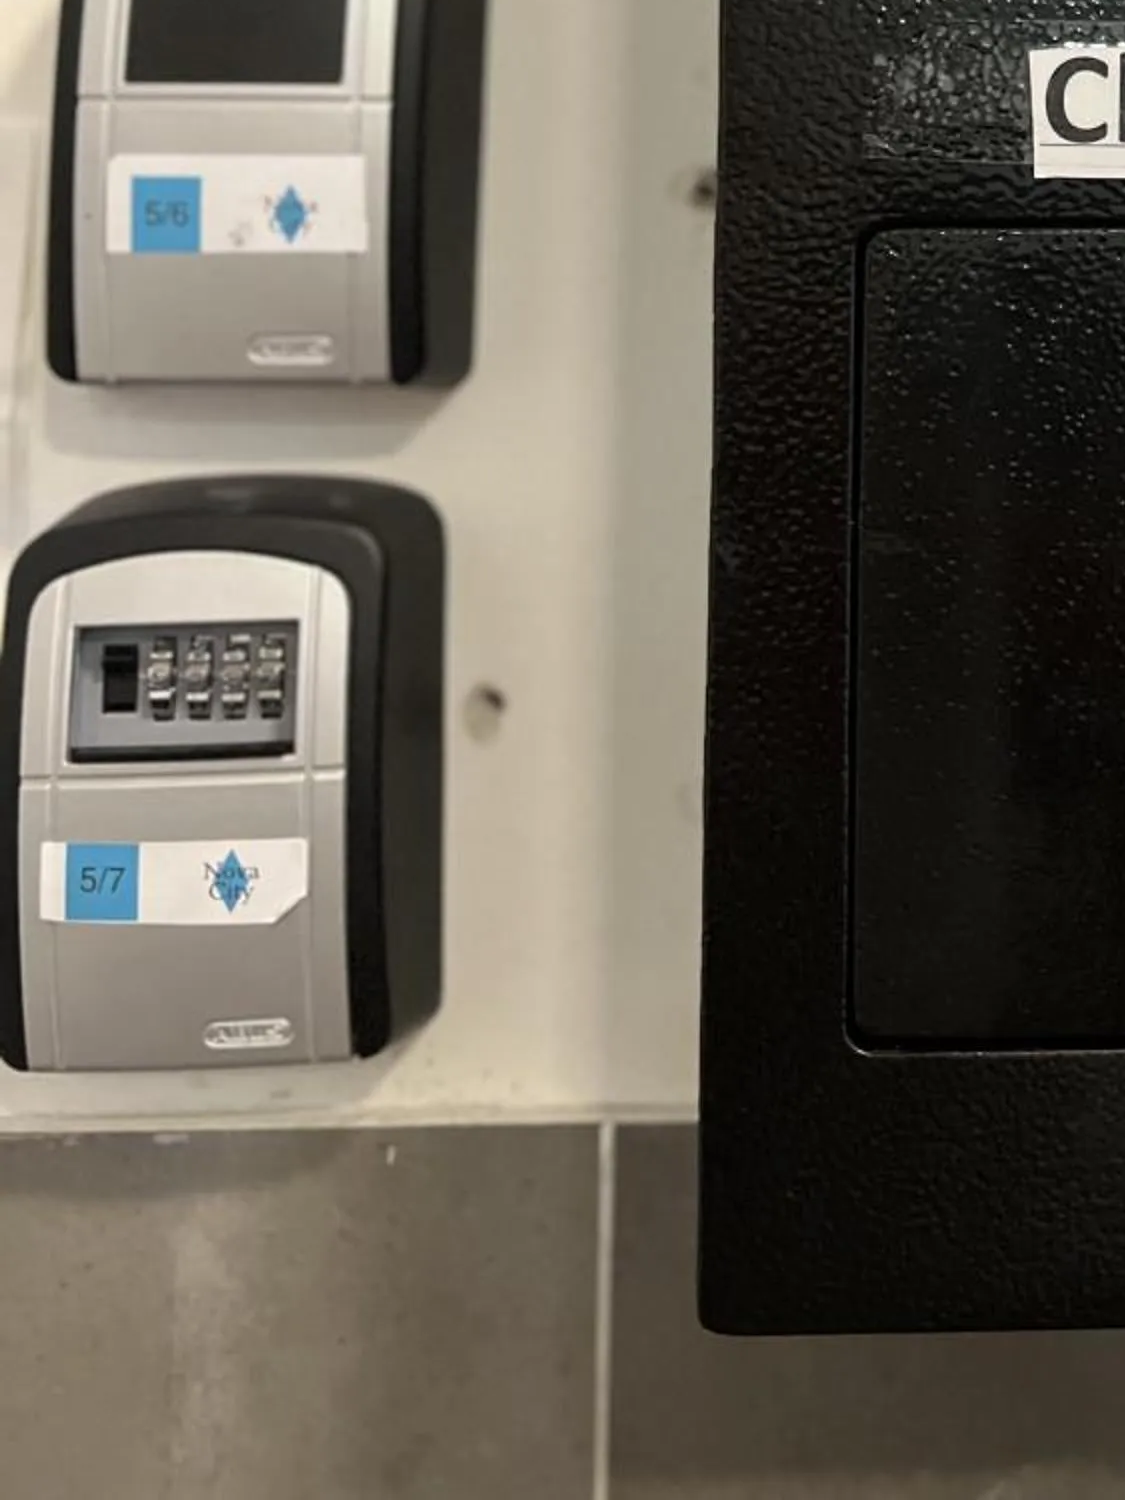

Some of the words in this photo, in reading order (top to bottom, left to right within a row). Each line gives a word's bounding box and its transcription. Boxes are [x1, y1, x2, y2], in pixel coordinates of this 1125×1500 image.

[144, 200, 190, 228] 5/6
[79, 866, 127, 894] 5/7
[203, 861, 260, 880] Nova
